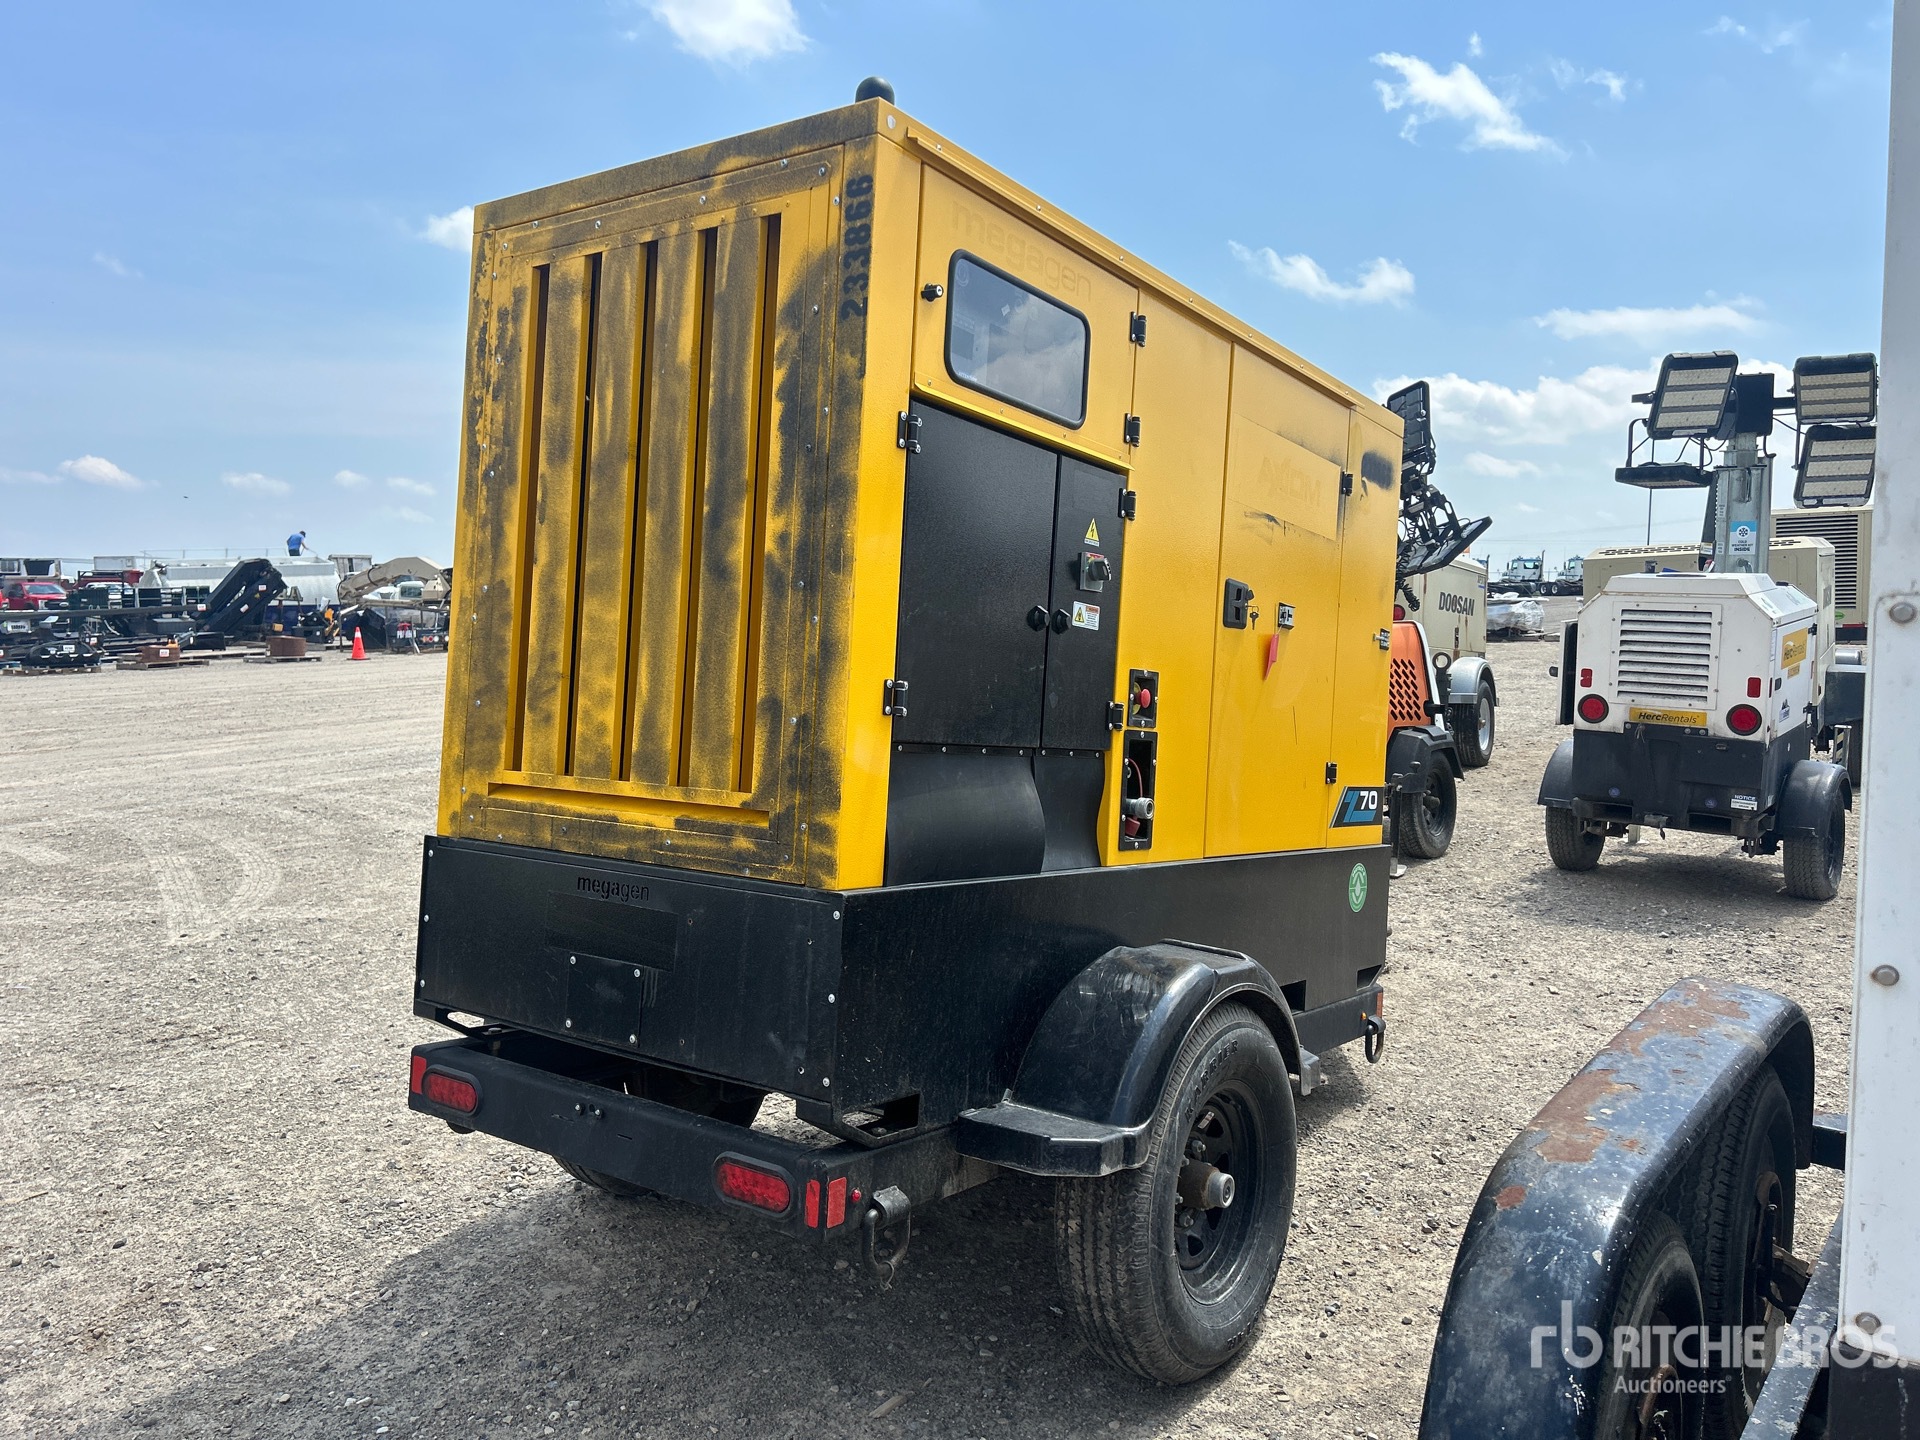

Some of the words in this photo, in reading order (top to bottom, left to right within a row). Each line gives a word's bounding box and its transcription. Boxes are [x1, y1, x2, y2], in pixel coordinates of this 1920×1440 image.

[1439, 592, 1475, 616] DOOSAN
[1638, 712, 1697, 724] HercRentals
[577, 876, 649, 902] megagen
